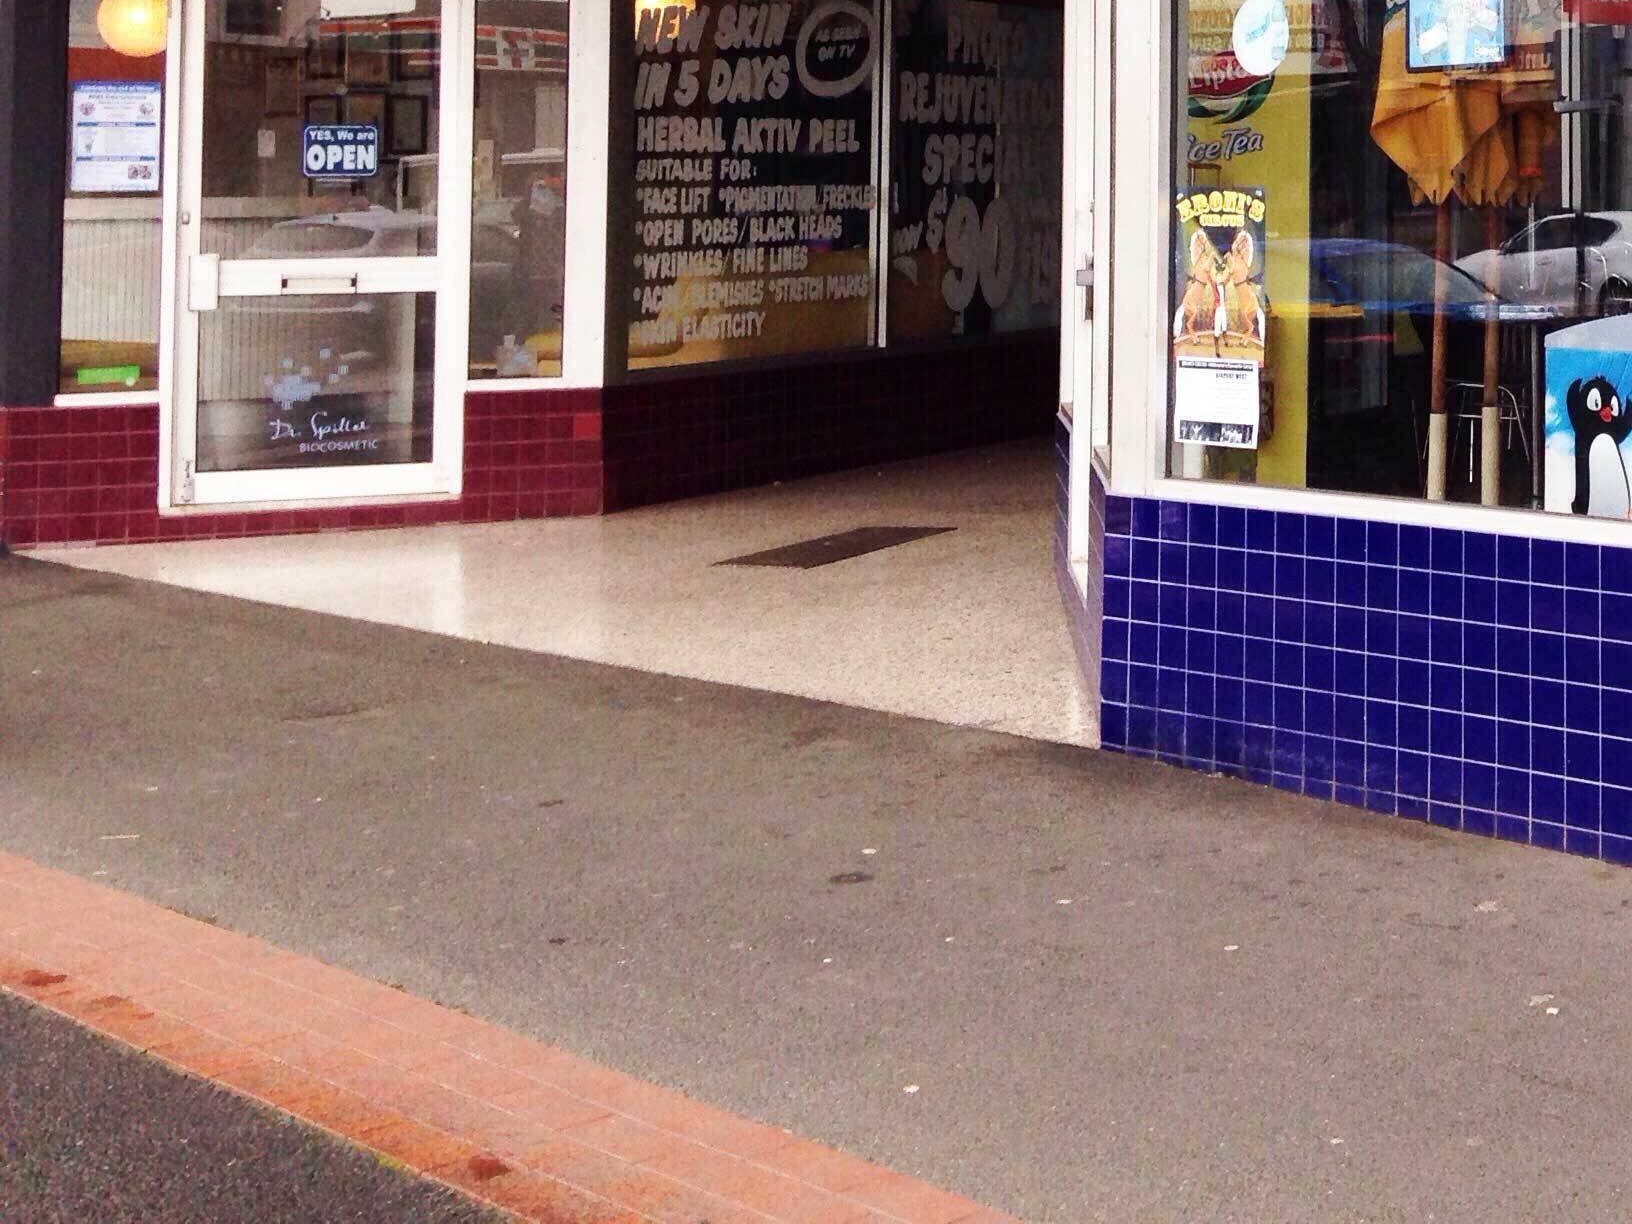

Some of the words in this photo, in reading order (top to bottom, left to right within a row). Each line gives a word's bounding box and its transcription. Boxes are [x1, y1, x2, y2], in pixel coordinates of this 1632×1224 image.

[633, 4, 709, 56] NEW
[713, 1, 792, 51] SKIN
[633, 61, 672, 110] IN
[674, 59, 700, 107] 5
[706, 54, 791, 104] DAYS
[336, 129, 354, 141] We
[636, 116, 727, 153] HERBAL
[731, 116, 802, 153] AKTIV
[807, 118, 861, 154] PEEL
[1222, 127, 1265, 161] Tea
[306, 143, 375, 172] OPEN
[635, 158, 713, 182] SUITABLE
[680, 186, 712, 214] LIFT
[750, 215, 796, 243] BLACK
[298, 438, 379, 454] BIOCOSMETIC
